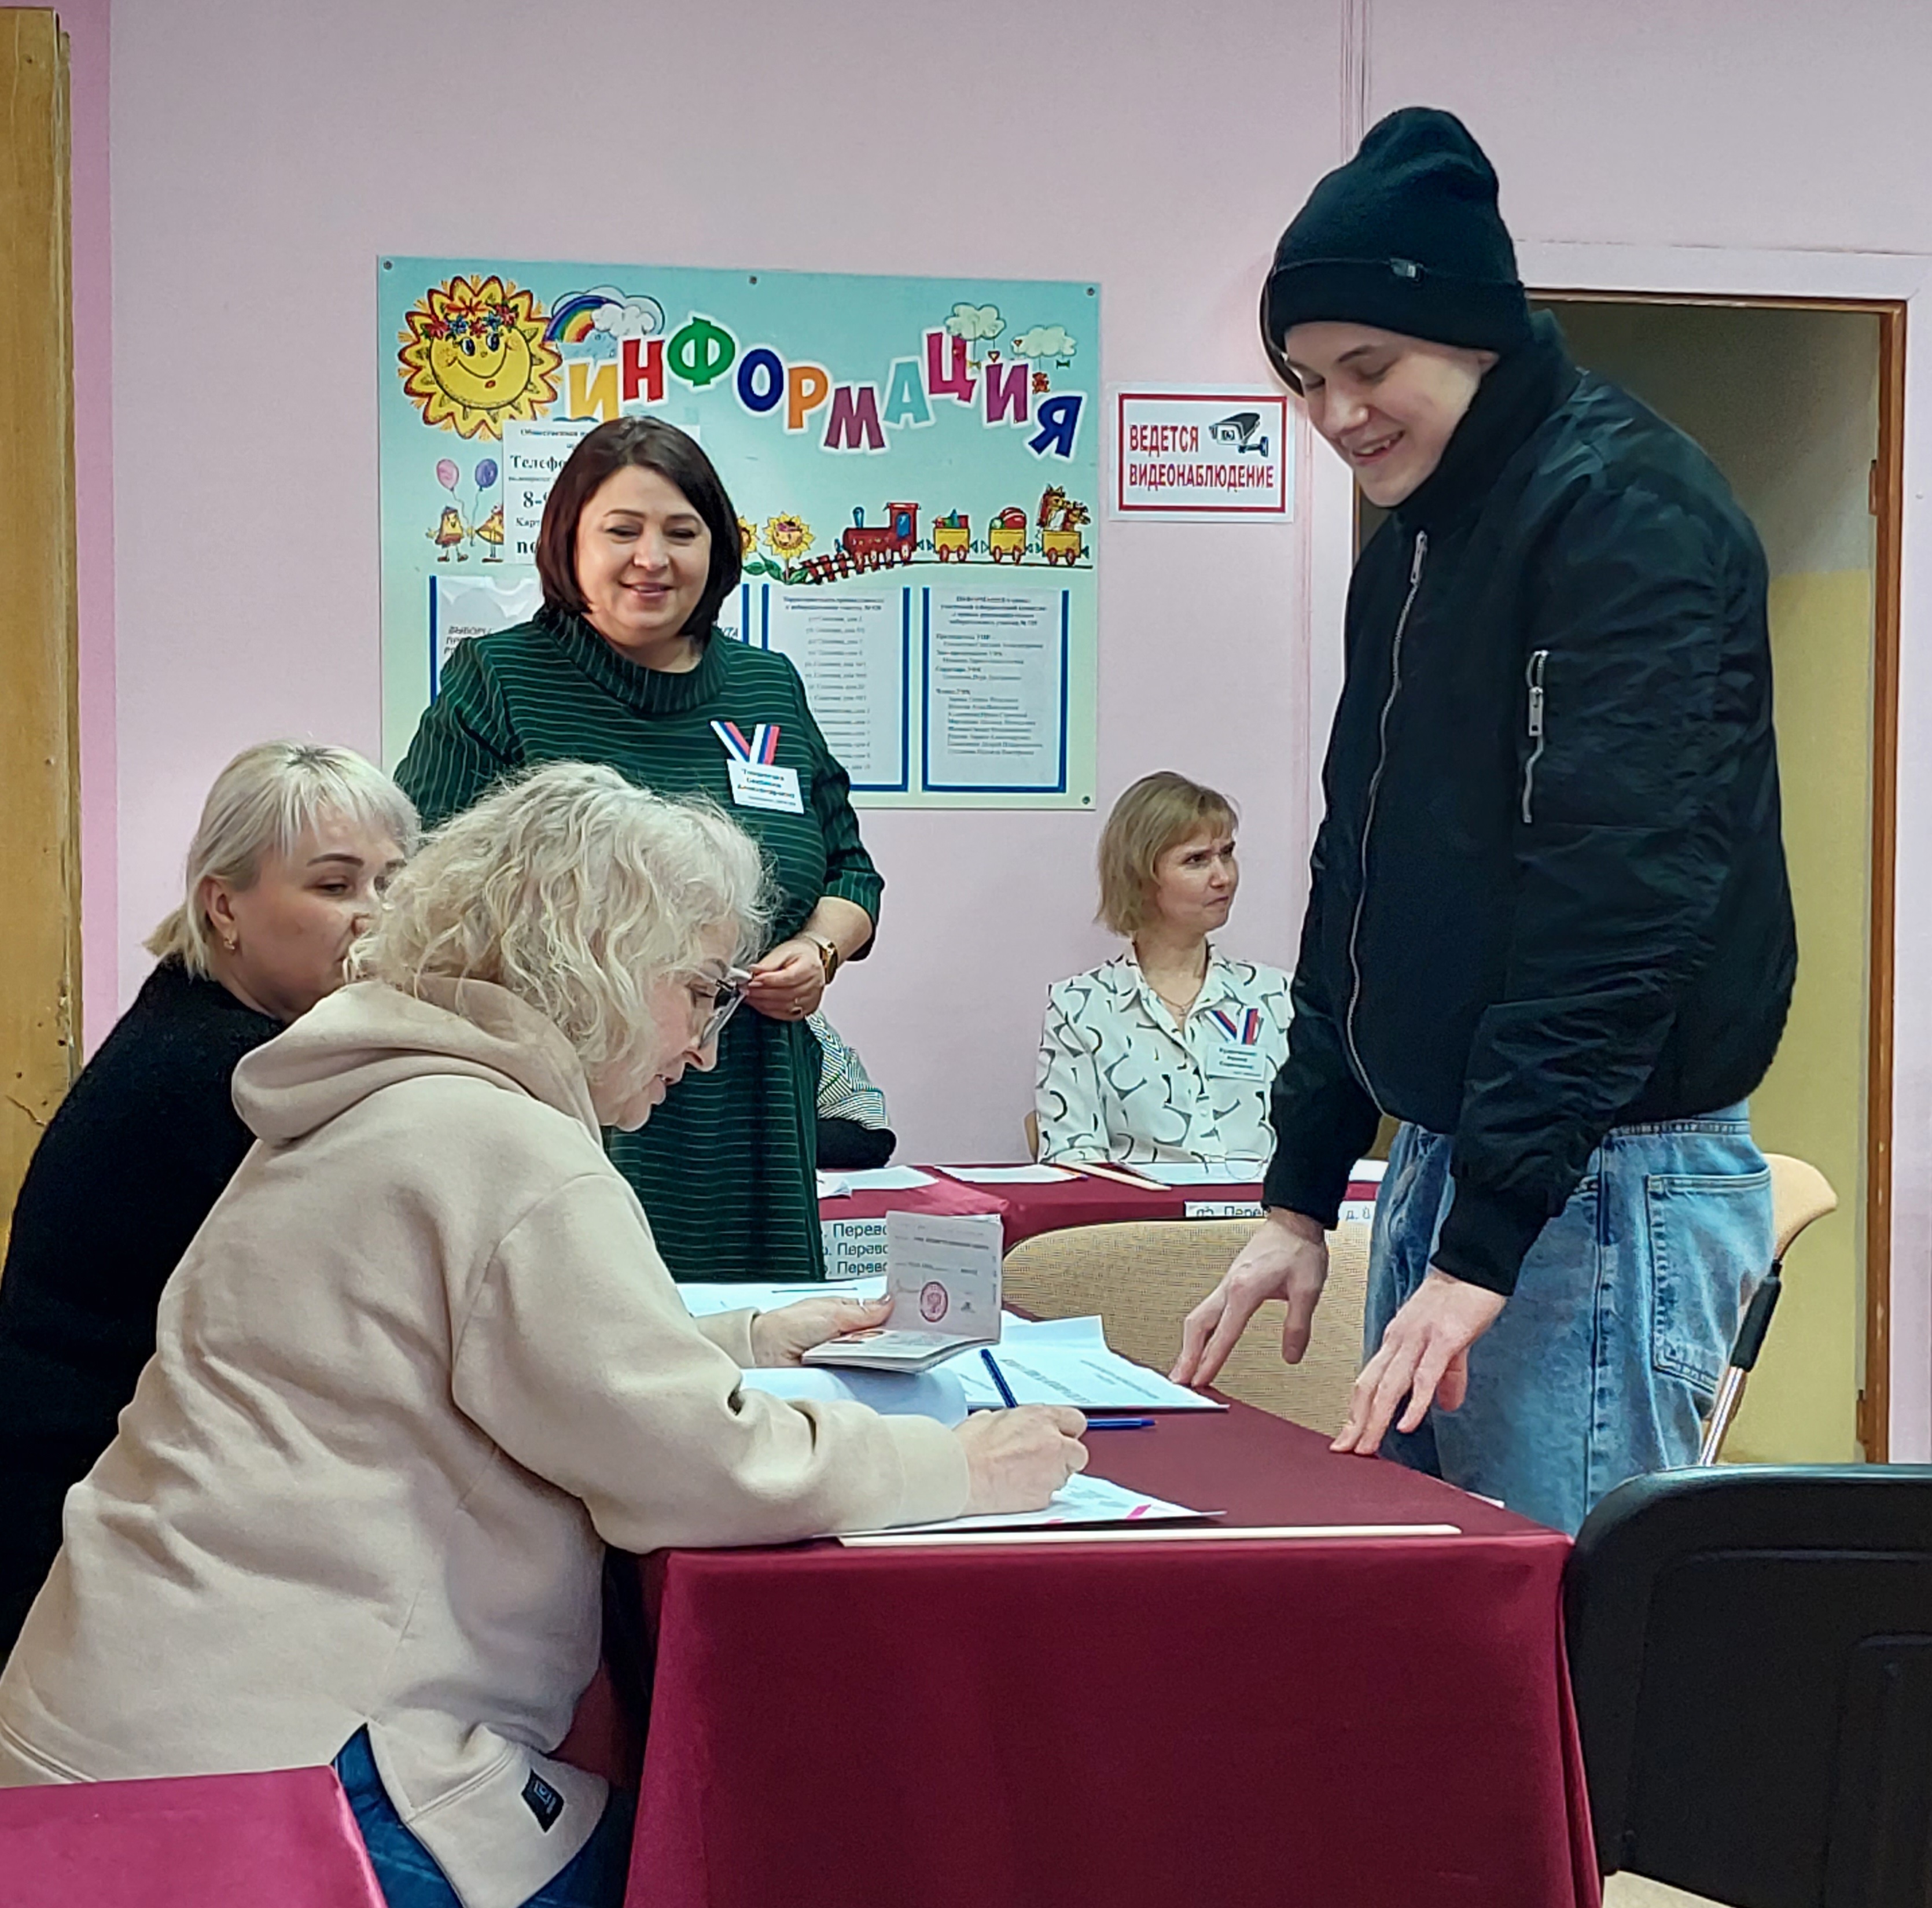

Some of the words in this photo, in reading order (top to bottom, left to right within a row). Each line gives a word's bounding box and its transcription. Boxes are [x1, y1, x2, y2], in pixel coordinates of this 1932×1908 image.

[568, 316, 1082, 458] ИНФОРМАЦИЯ
[1129, 425, 1199, 458] ВЕДЕТСЯ
[1129, 463, 1274, 492] ВИДЕОНАБЛЮДЕНИЕ
